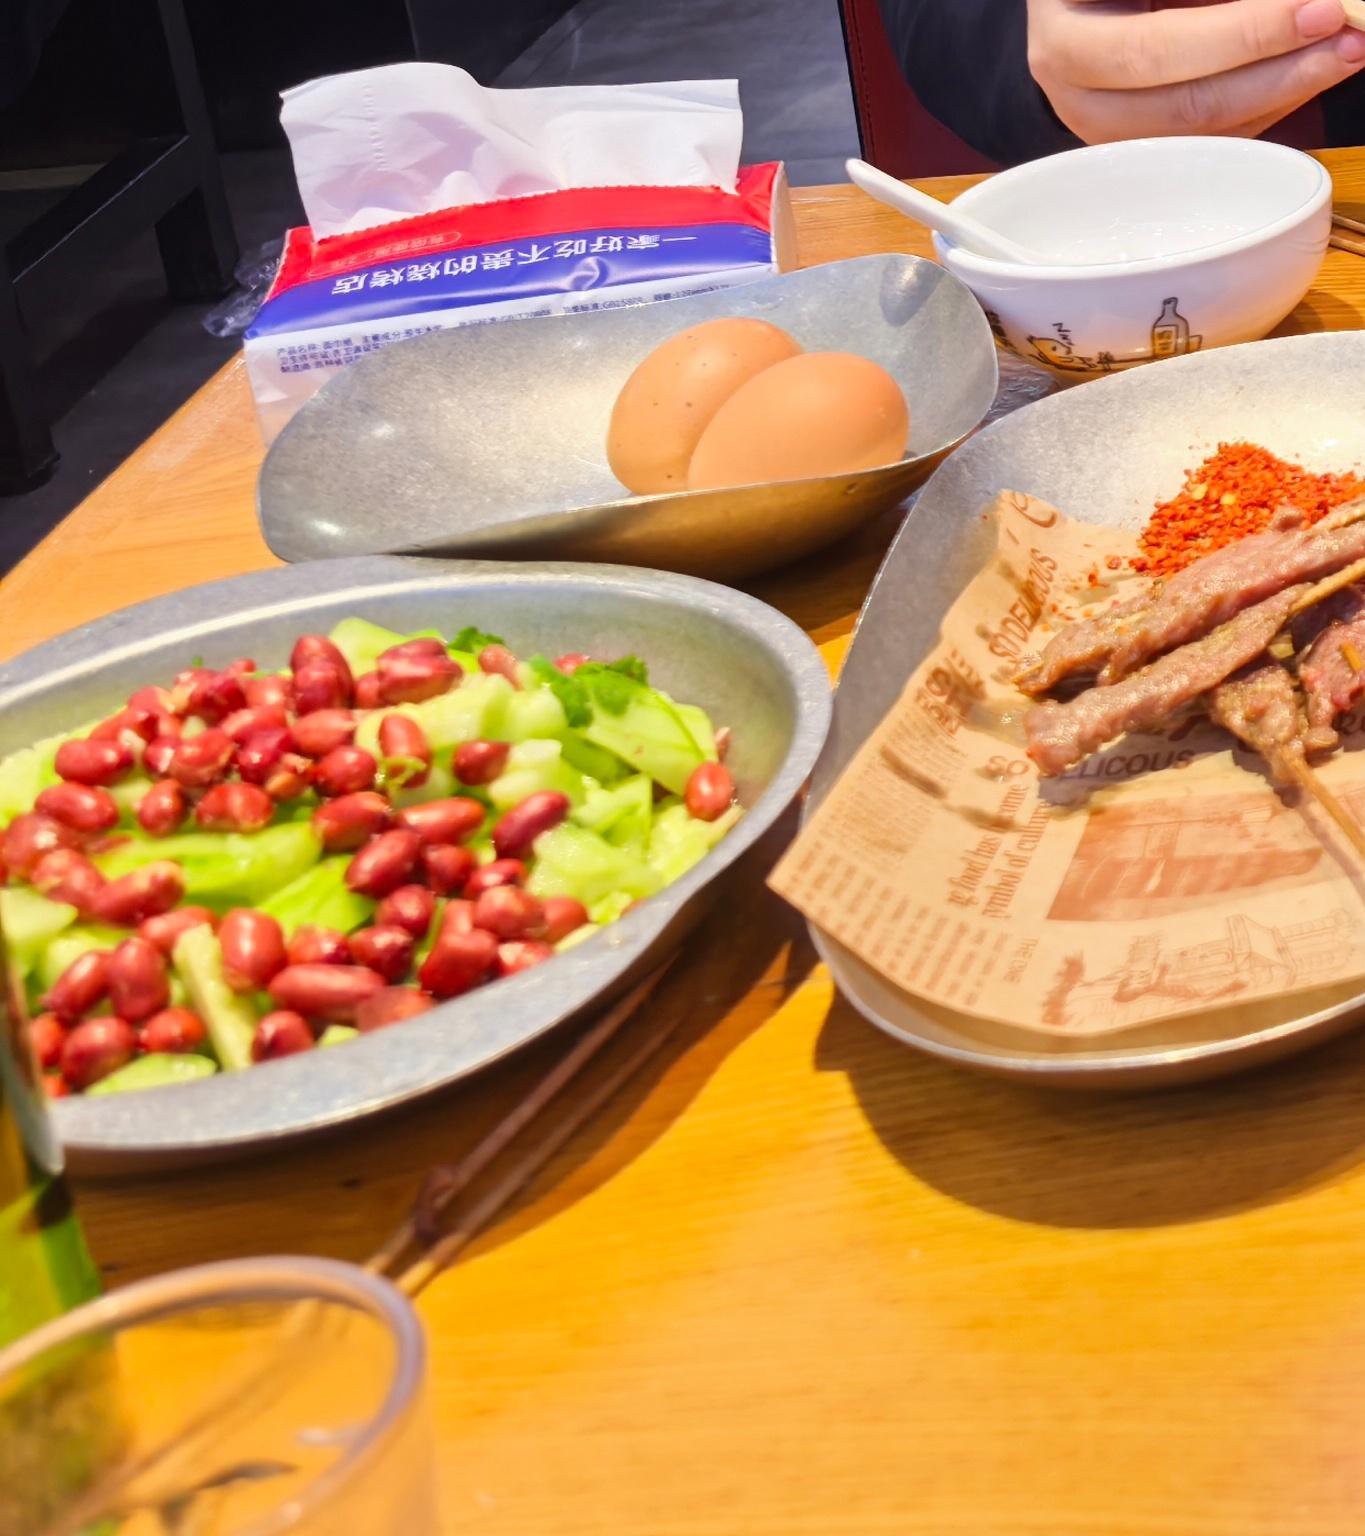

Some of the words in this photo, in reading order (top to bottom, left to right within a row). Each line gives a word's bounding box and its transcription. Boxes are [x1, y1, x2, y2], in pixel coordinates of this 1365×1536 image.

[331, 233, 697, 296] 一家好吃不贵的烧烤店
[1054, 749, 1195, 782] LICOUS
